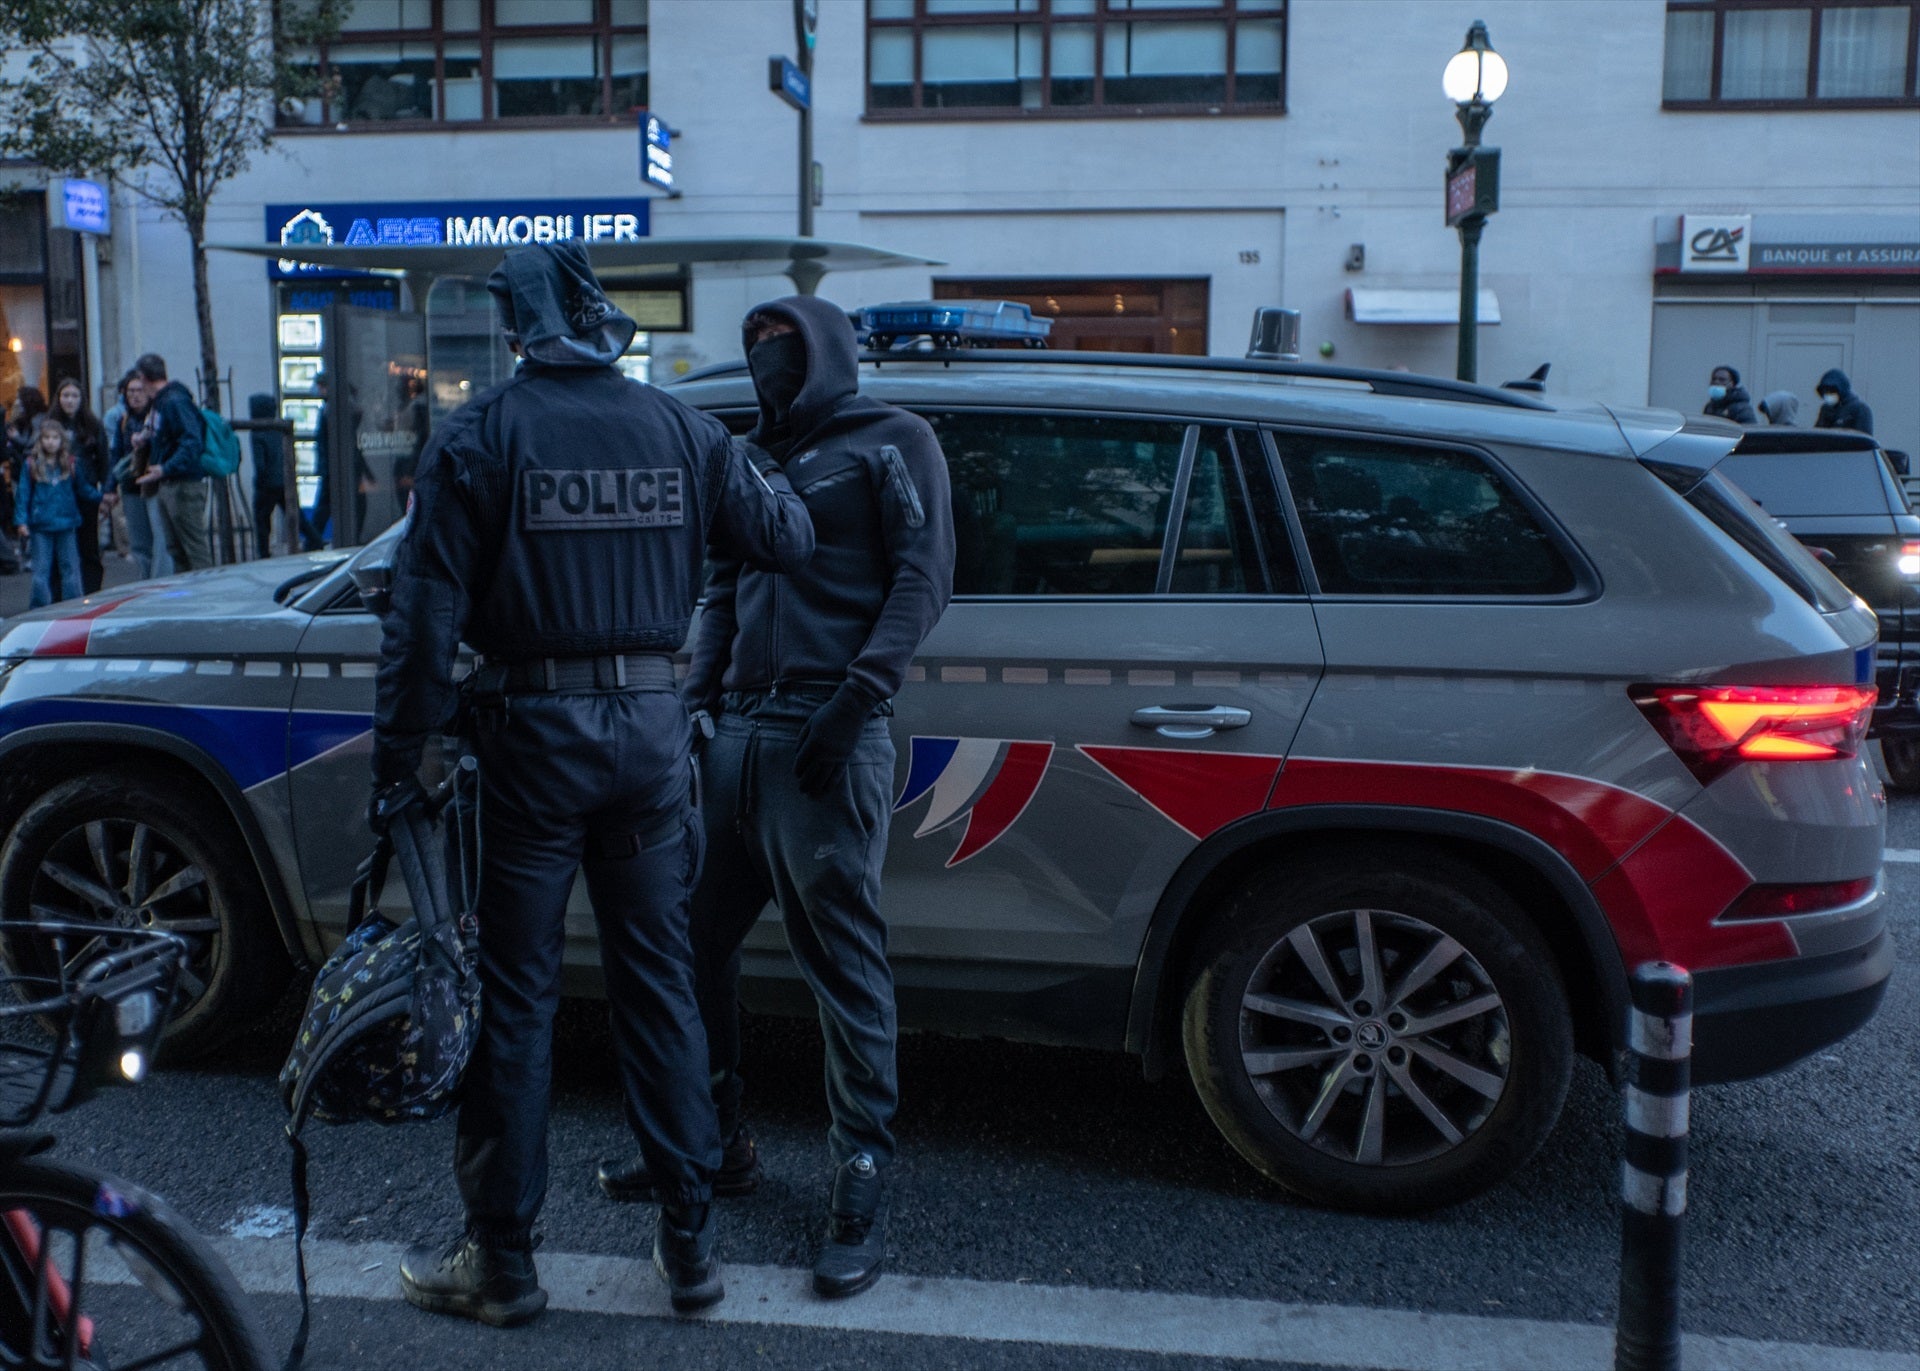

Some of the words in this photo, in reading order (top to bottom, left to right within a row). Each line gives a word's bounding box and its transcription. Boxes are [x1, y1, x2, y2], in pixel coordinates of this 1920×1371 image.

[344, 217, 442, 246] ABS
[1762, 249, 1831, 265] BANQUE
[1836, 251, 1852, 263] et
[528, 471, 681, 516] POLICE
